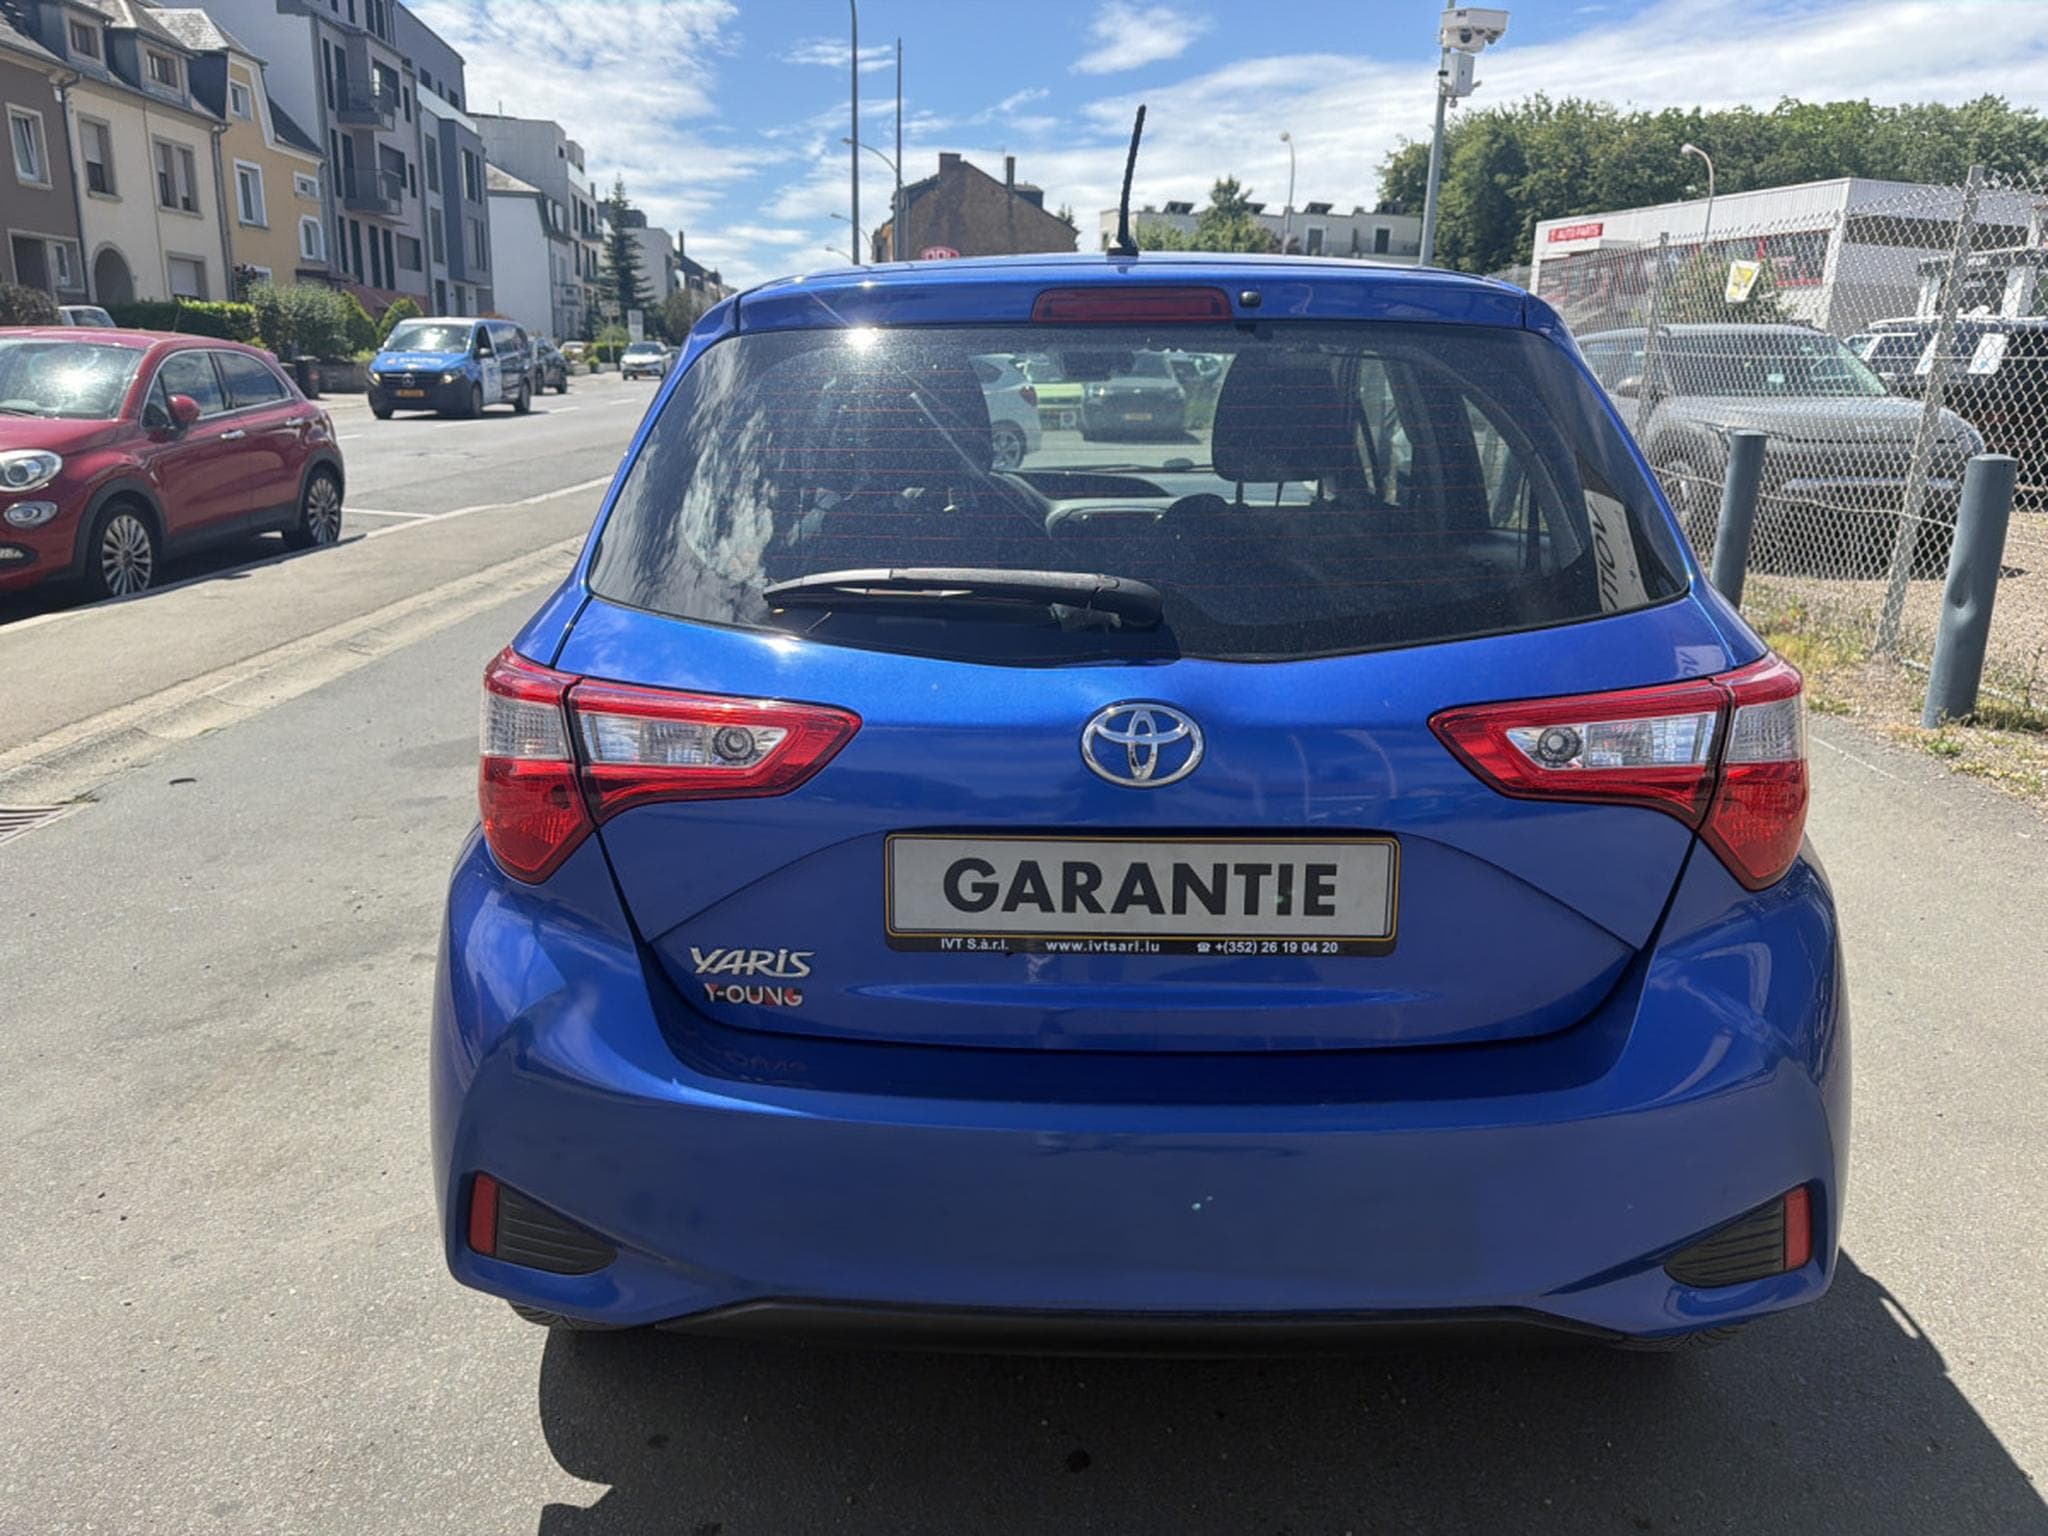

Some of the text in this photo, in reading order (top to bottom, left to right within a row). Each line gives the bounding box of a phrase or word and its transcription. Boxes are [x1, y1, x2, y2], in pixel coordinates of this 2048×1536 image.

[943, 857, 1338, 916] GARANTIE
[941, 938, 963, 949] IVT
[1046, 940, 1160, 952] www.ivtsarl.lu
[1215, 940, 1338, 954] +(352) 26 19 04 20
[690, 947, 815, 977] YARIS
